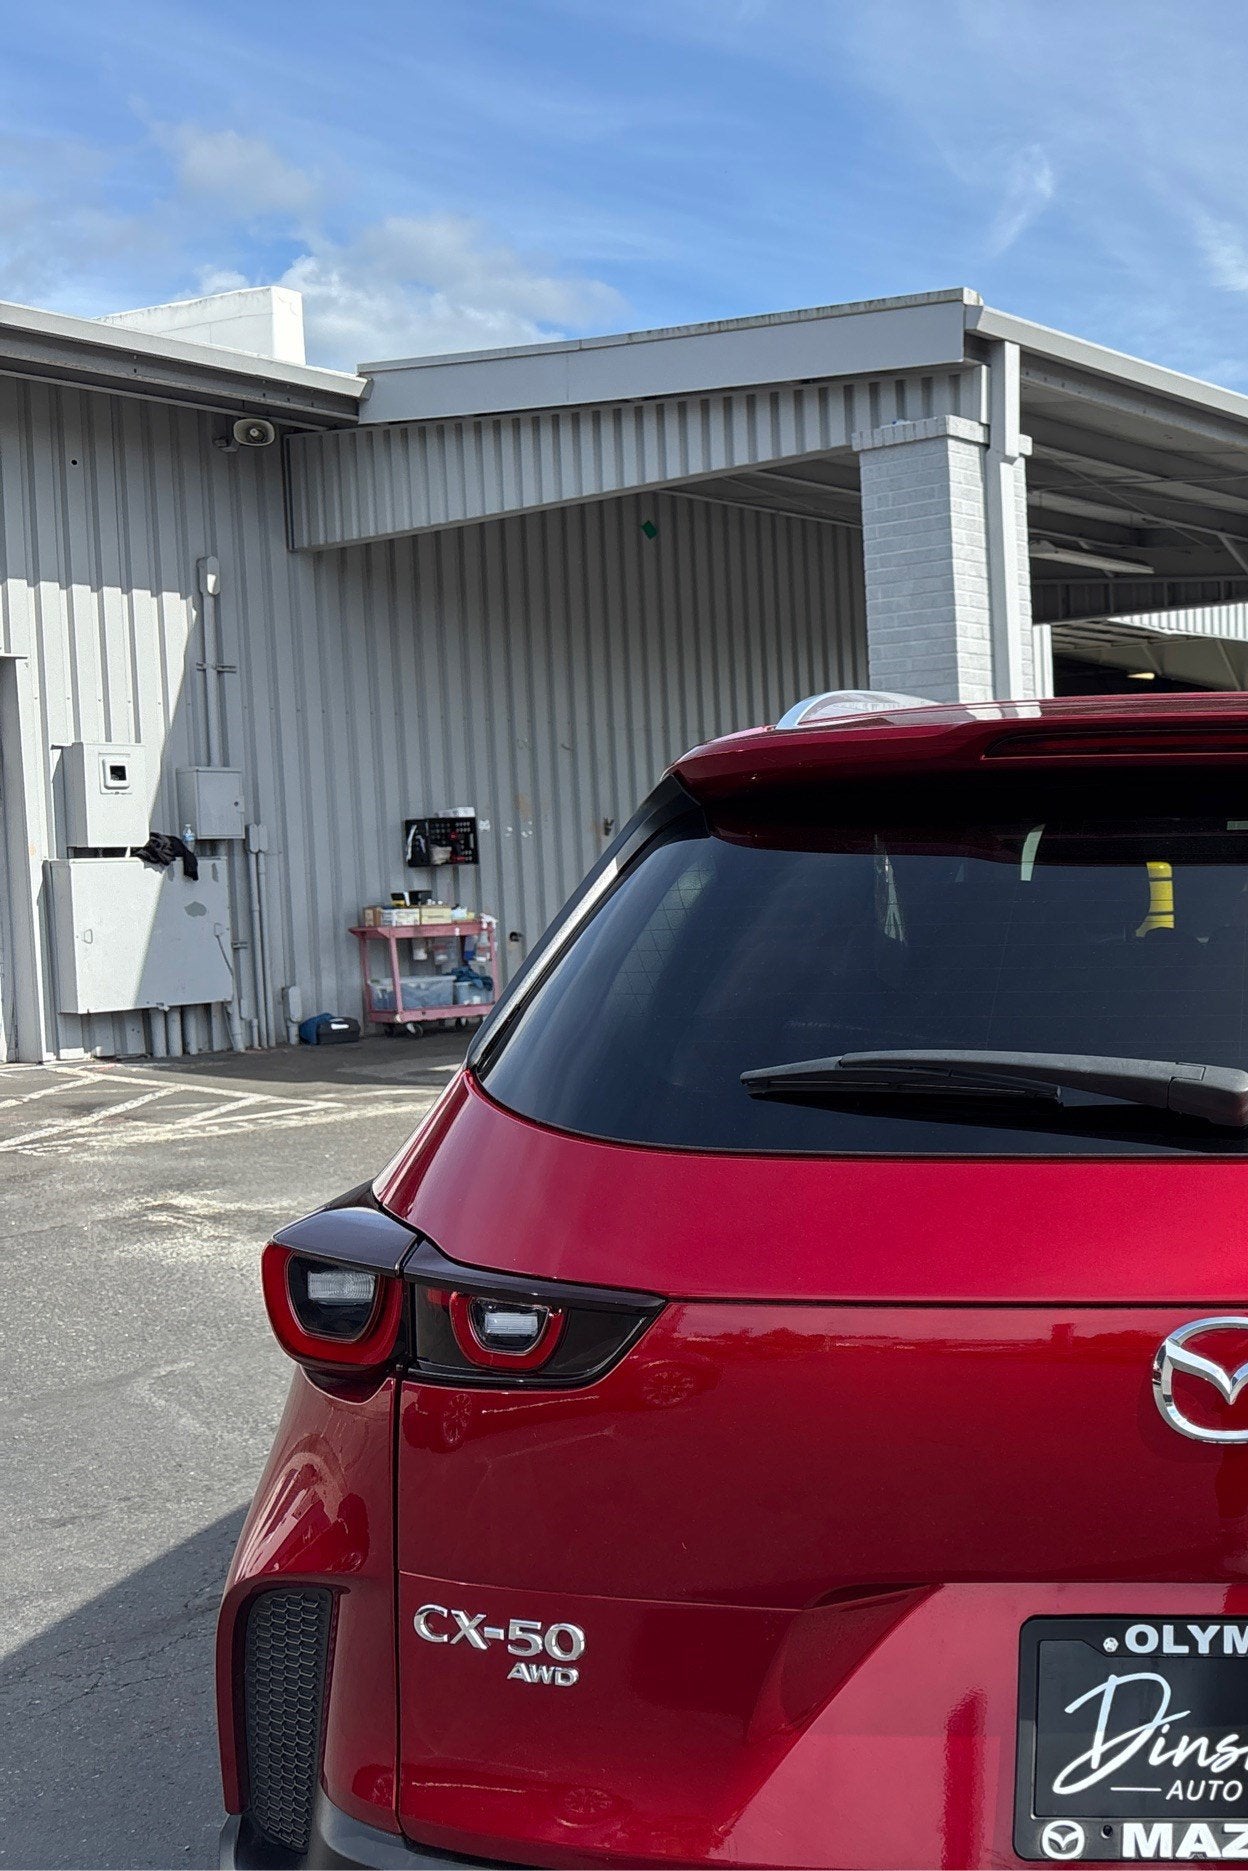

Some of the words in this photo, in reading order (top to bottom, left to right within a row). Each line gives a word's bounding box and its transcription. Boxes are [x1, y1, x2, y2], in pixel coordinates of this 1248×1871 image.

[413, 1604, 587, 1662] CX-50
[507, 1662, 579, 1687] AWD
[1166, 1780, 1242, 1802] AUTO
